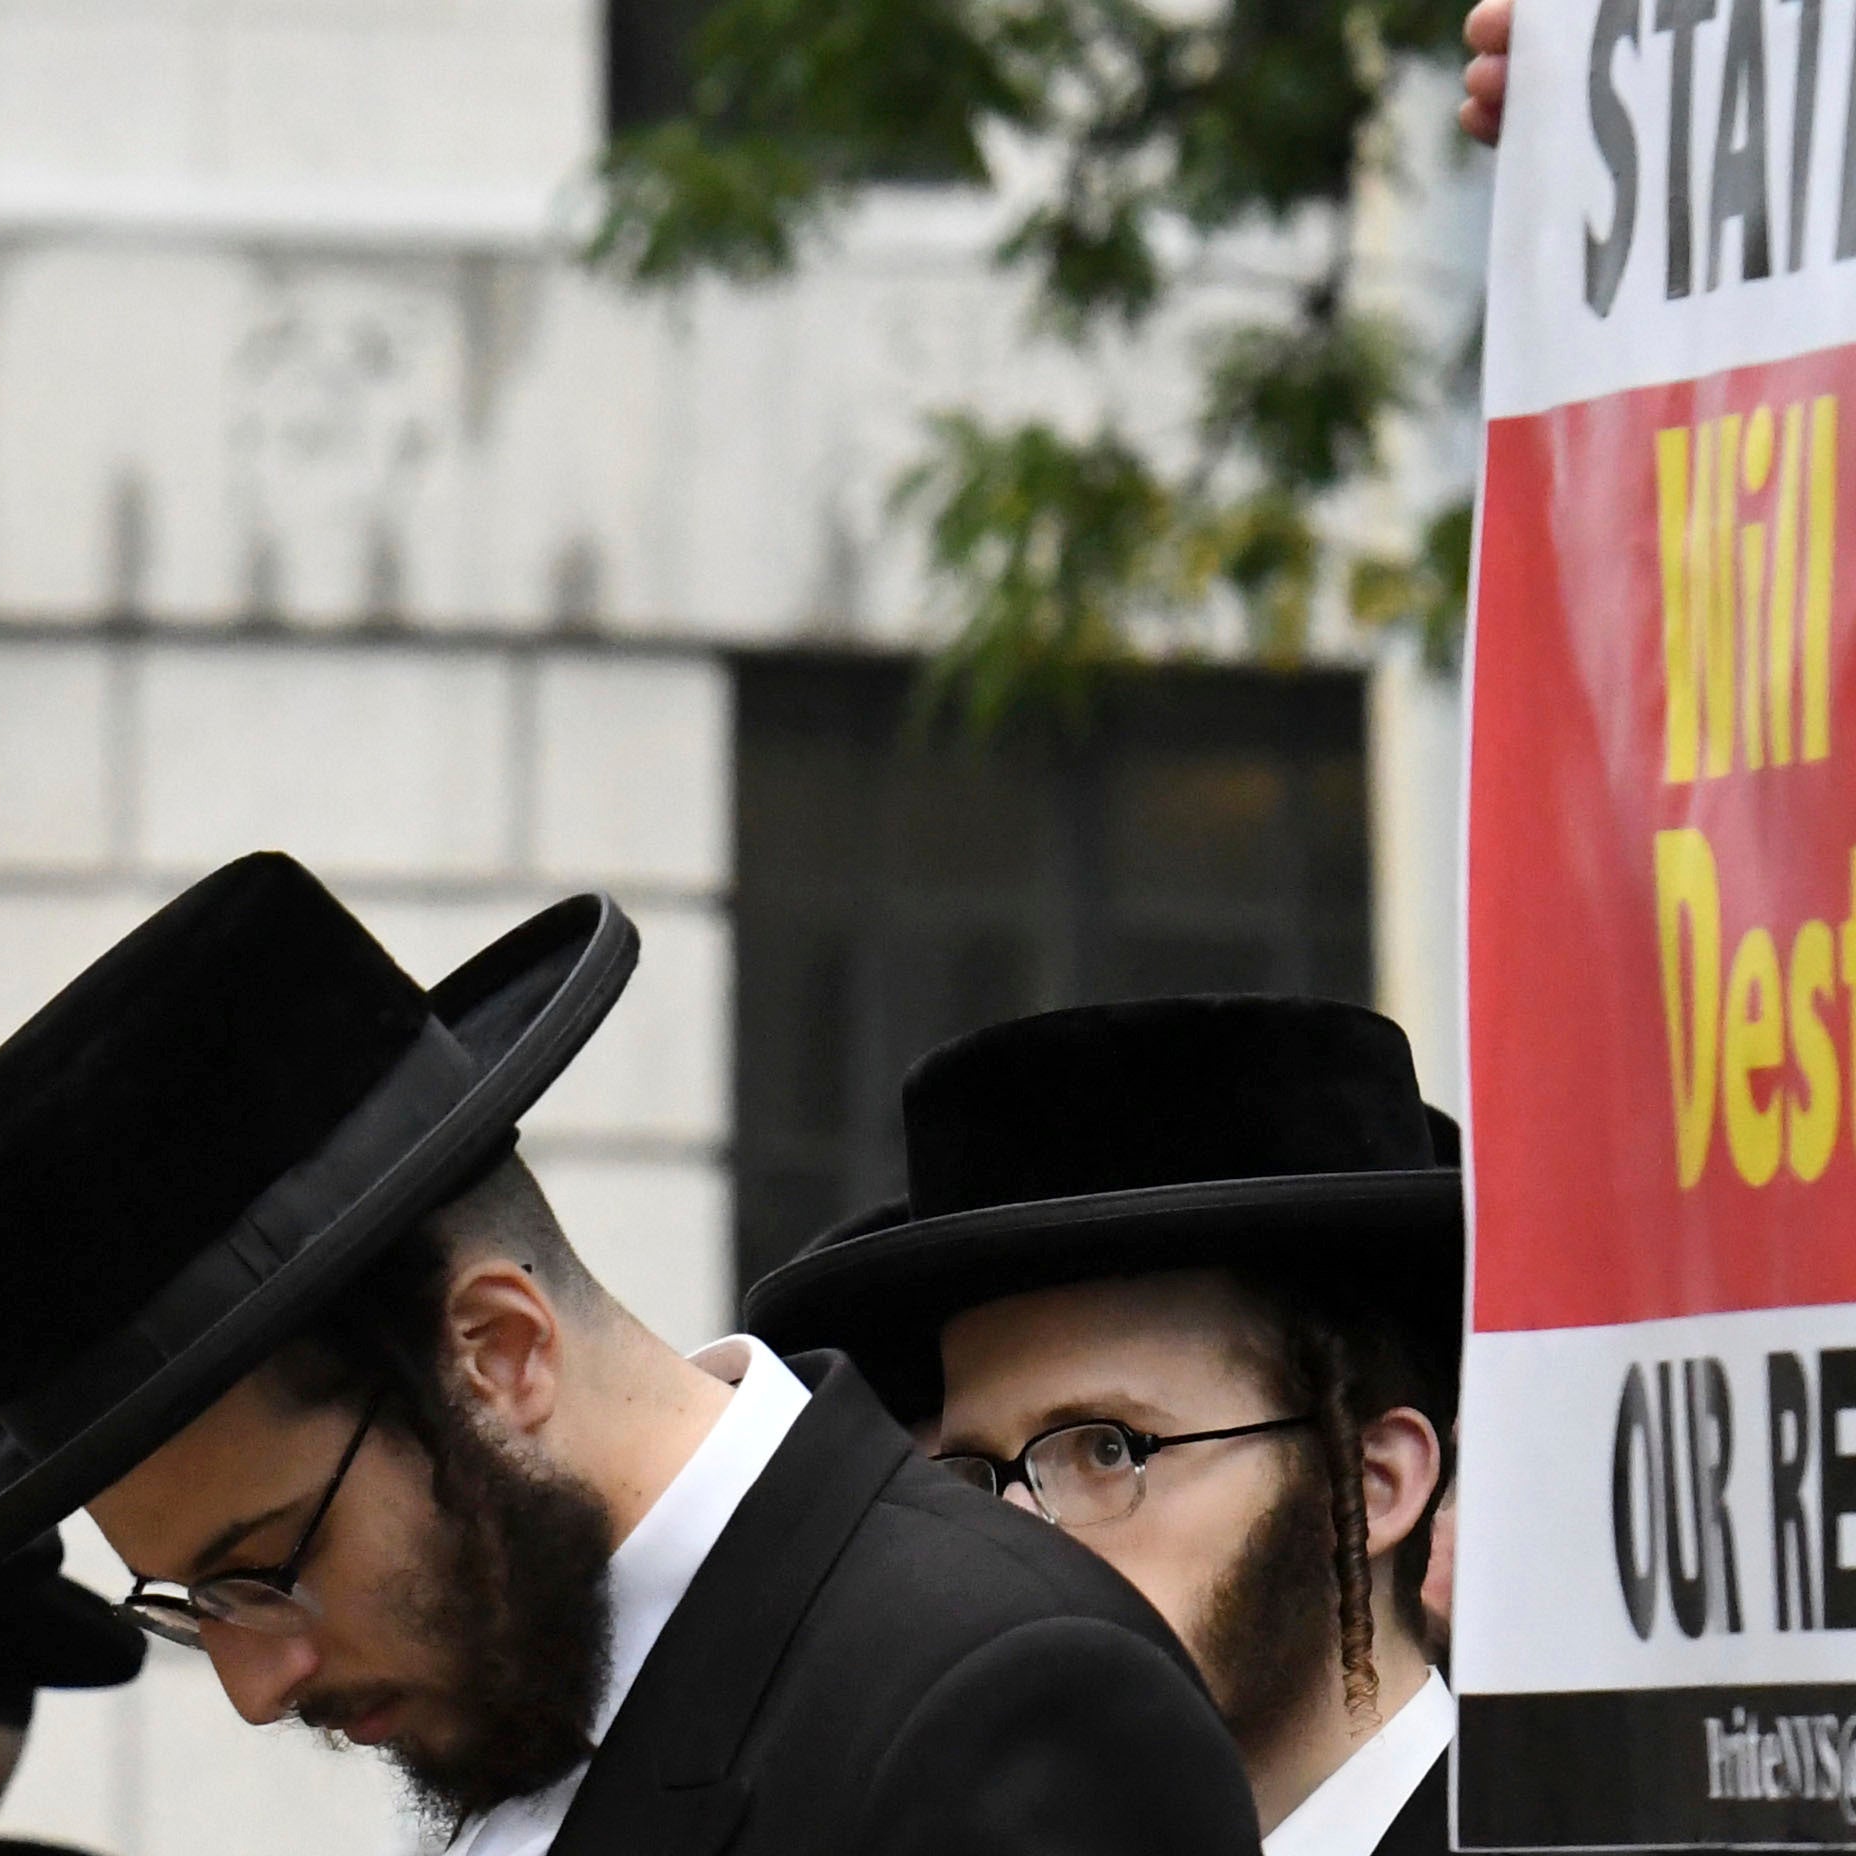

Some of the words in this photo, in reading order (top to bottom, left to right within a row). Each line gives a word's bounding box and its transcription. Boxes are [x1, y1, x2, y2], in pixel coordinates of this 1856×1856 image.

[1584, 0, 1856, 318] STAT
[1656, 395, 1837, 783] Will
[1611, 1355, 1744, 1641] OUR
